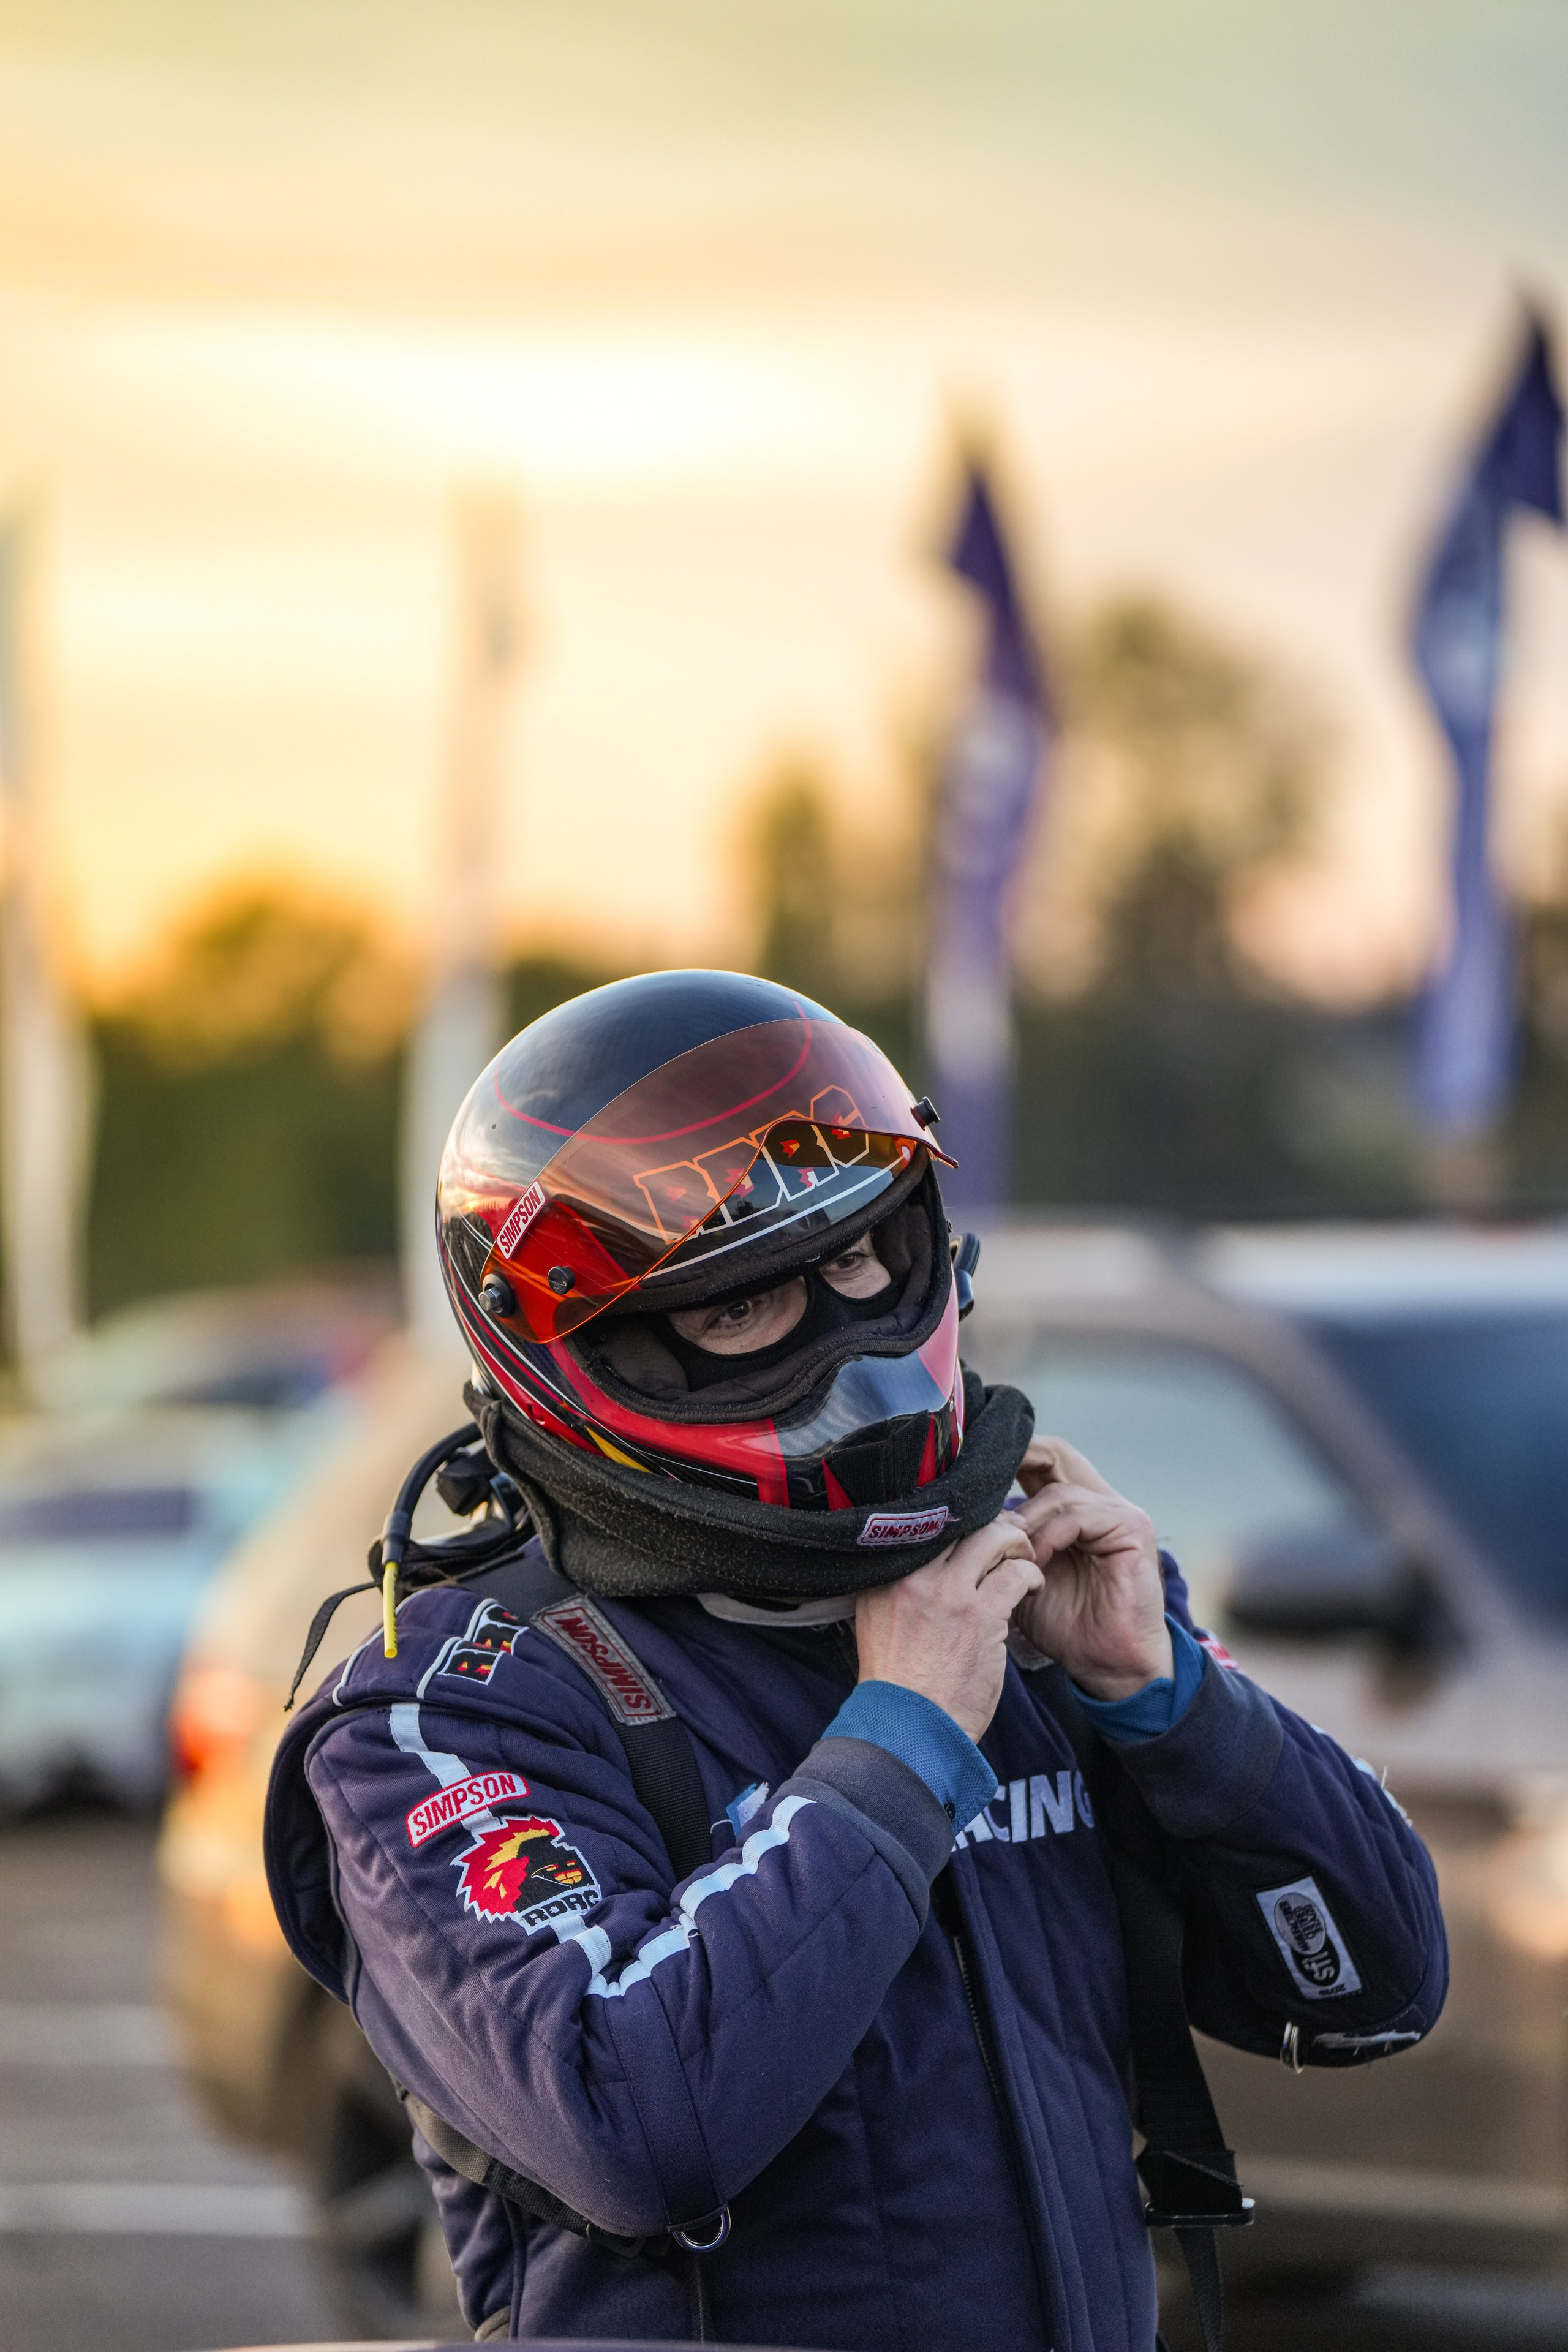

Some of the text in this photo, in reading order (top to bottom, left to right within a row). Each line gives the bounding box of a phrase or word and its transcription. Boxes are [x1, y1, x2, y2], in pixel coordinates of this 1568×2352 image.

[499, 1186, 541, 1254] SIMPSON
[867, 1519, 940, 1539] SIMPSON
[555, 1616, 652, 1711] SIMPSON
[413, 1774, 516, 1836] SIMPSON
